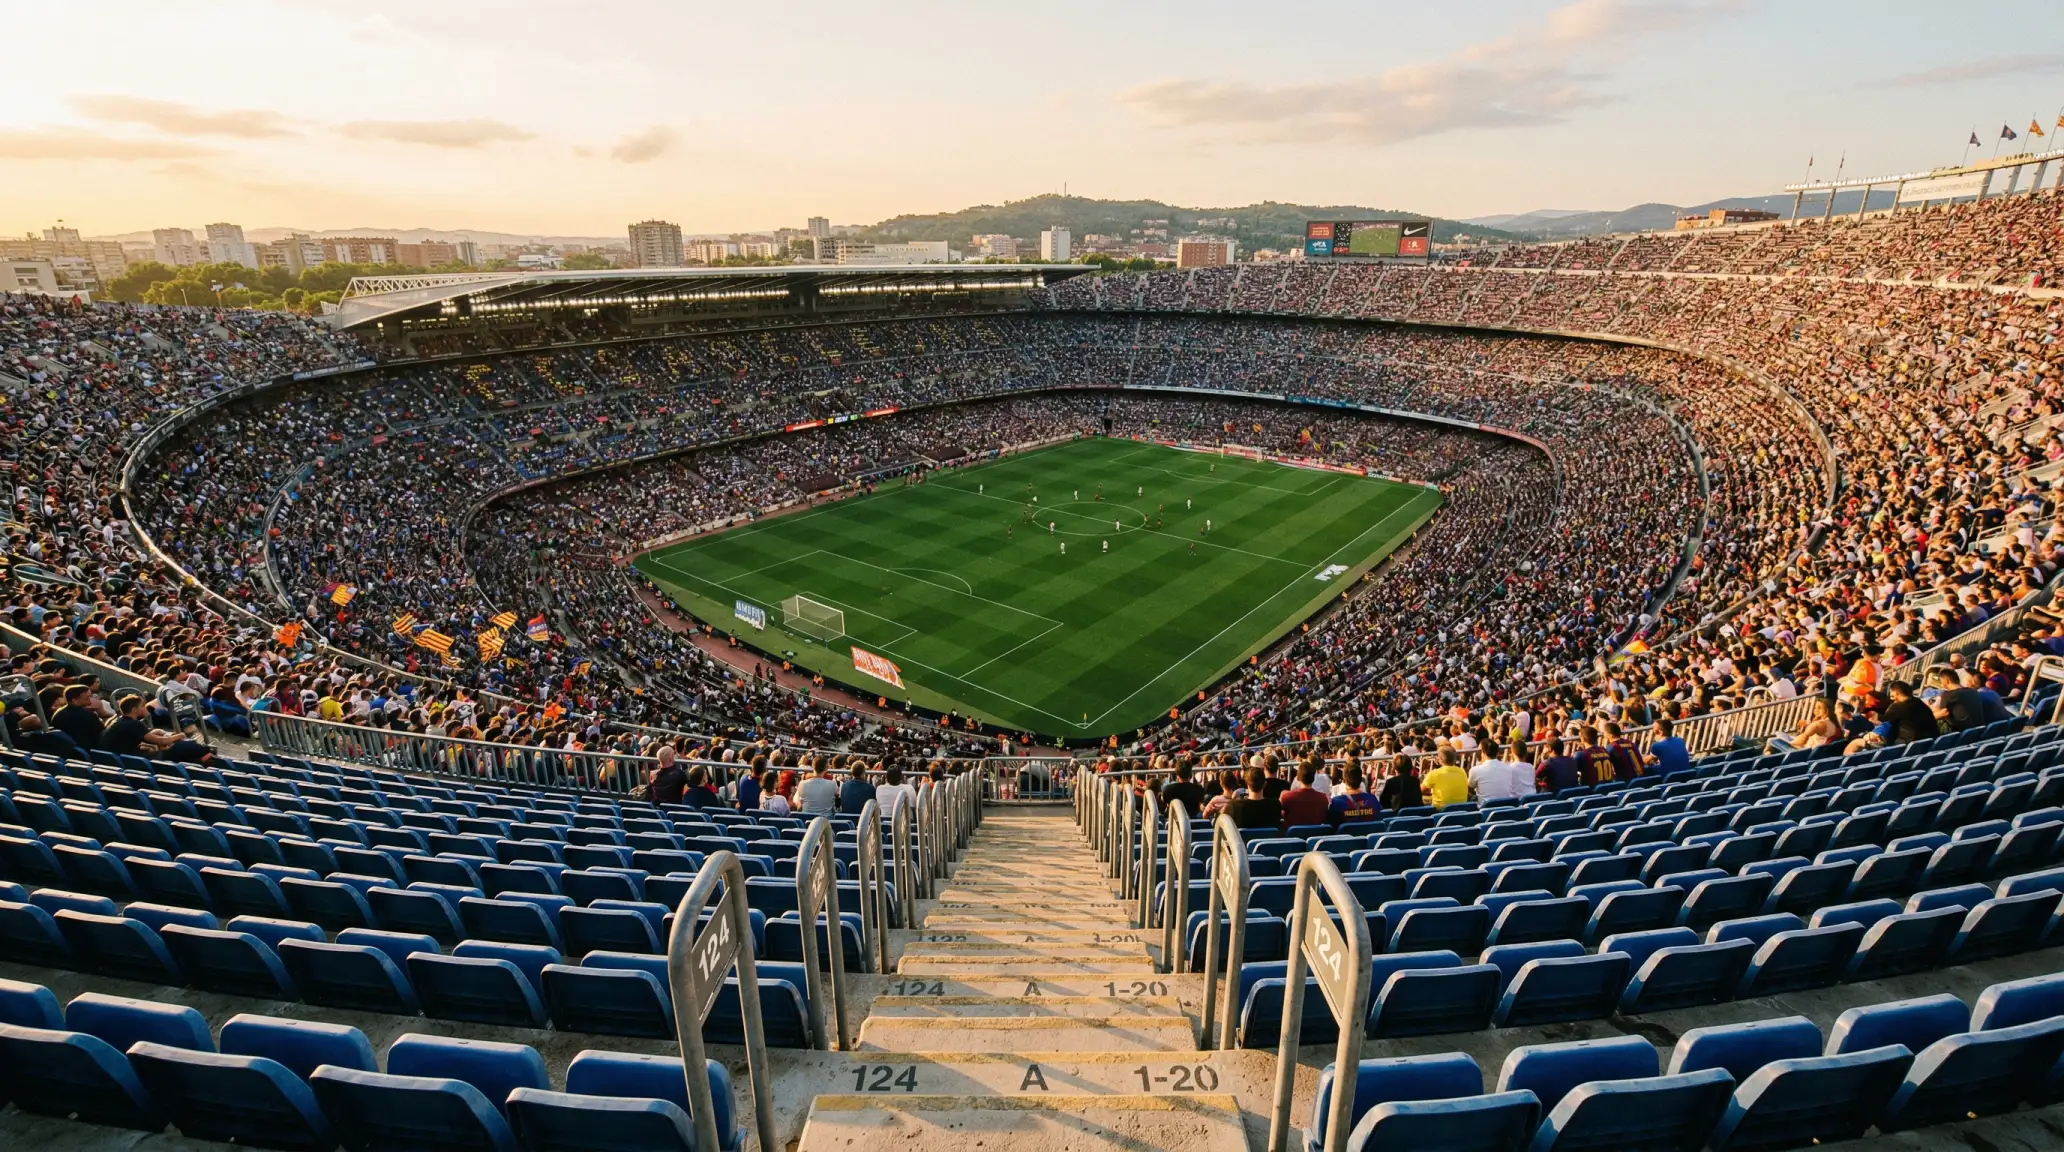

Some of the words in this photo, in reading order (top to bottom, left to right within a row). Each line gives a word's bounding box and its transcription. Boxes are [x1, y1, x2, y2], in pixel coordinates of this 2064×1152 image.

[1594, 759, 1612, 781] 10
[698, 913, 730, 981] 124
[1312, 916, 1342, 983] 124
[895, 981, 945, 997] 124
[1023, 981, 1042, 997] A
[1103, 981, 1168, 997] 1-20
[851, 1064, 918, 1093] 124
[1019, 1063, 1049, 1092] A
[1133, 1064, 1219, 1092] 1-20
